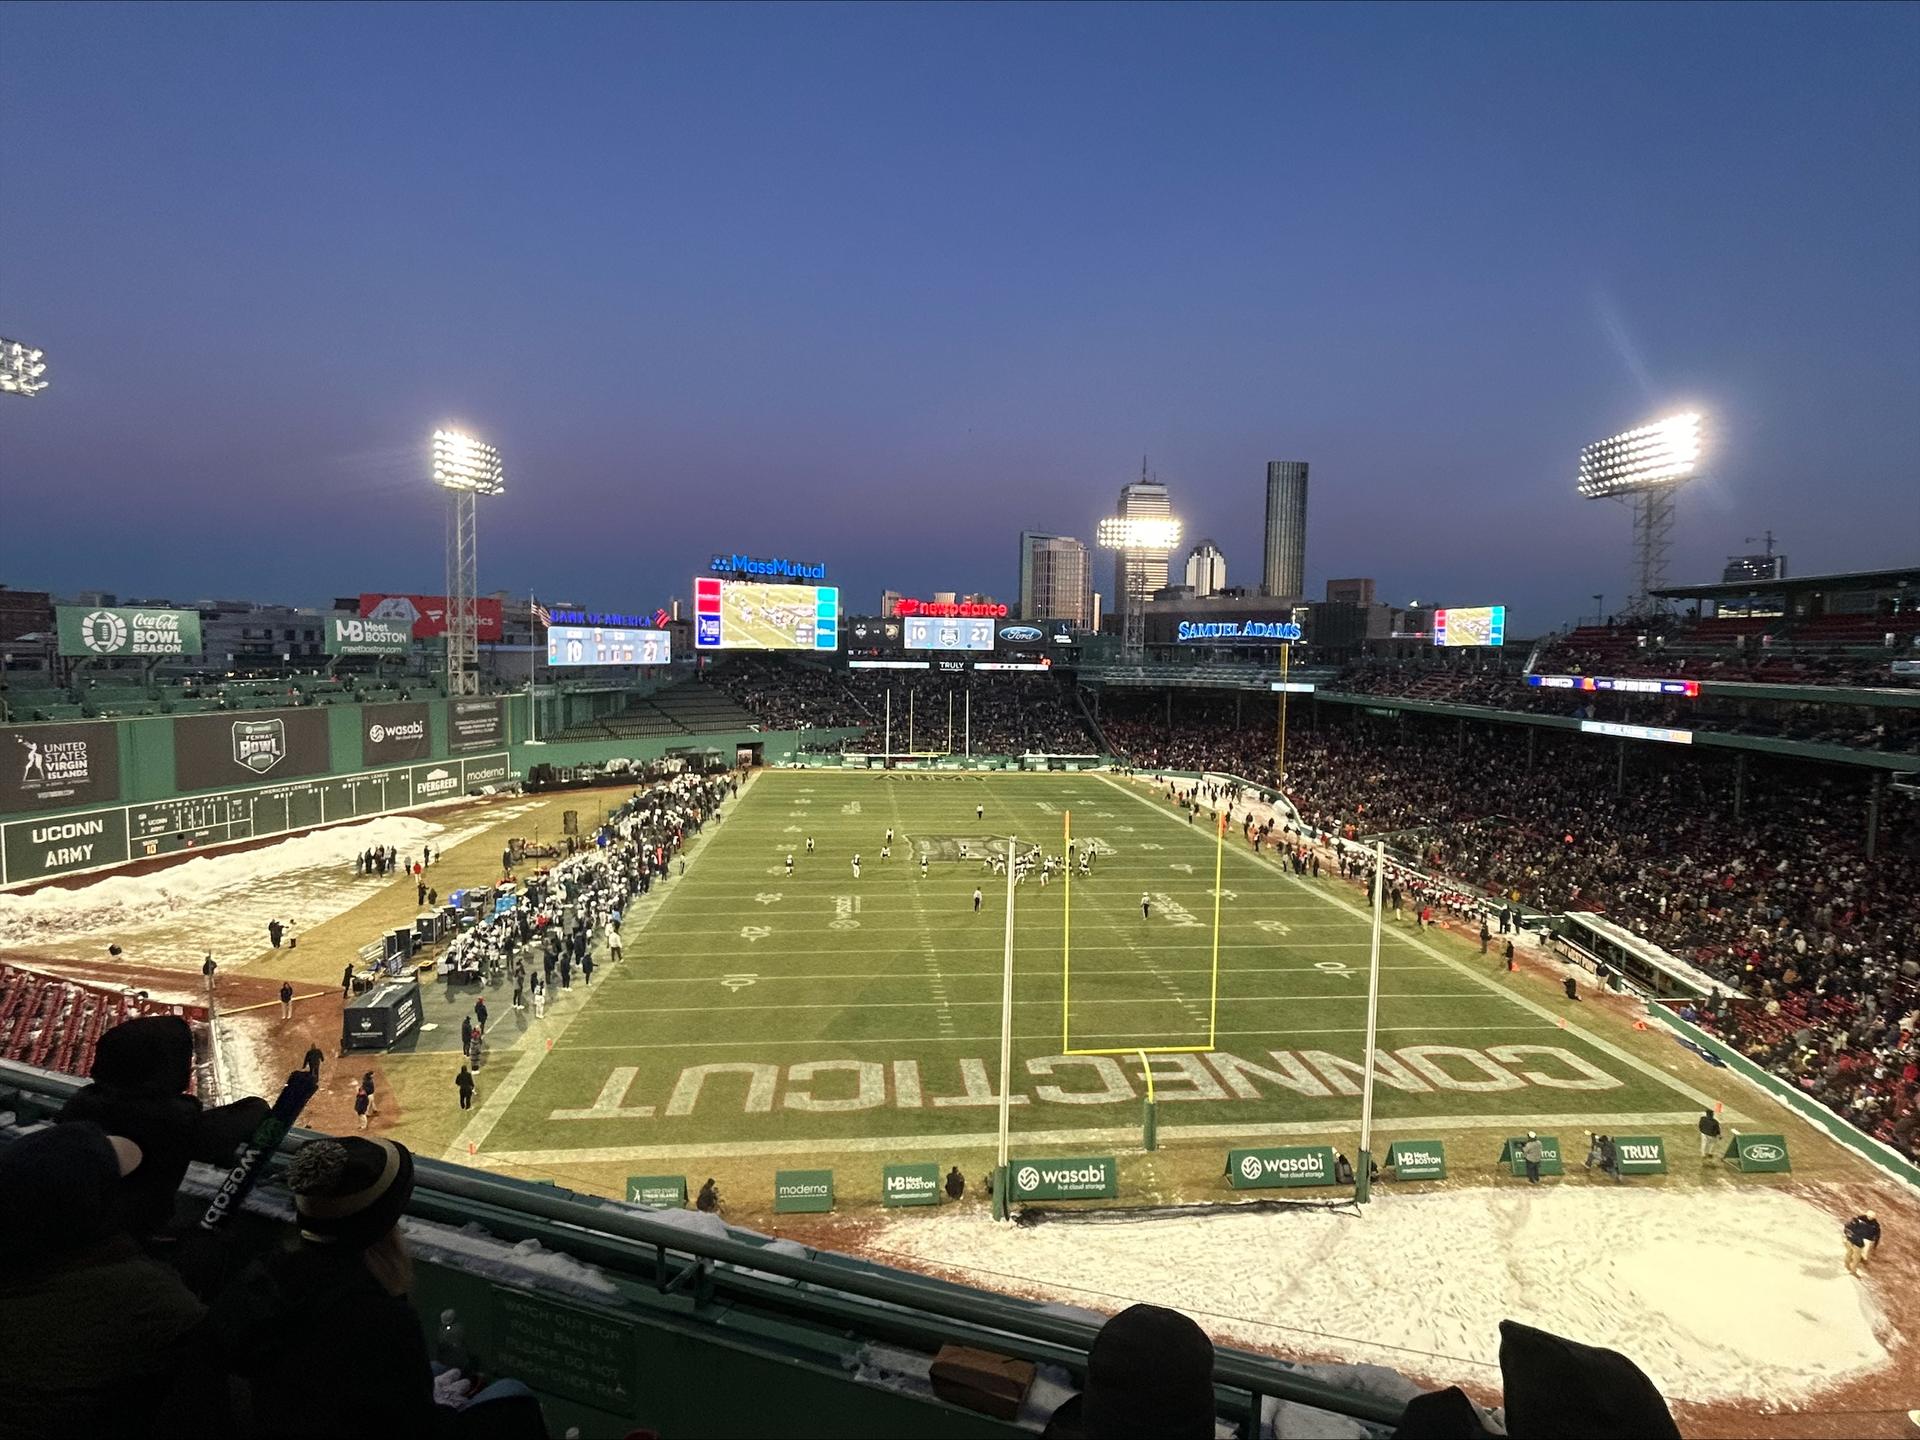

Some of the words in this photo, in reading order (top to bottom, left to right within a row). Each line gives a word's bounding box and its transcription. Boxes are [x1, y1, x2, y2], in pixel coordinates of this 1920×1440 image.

[732, 554, 825, 579] MassMutual
[550, 608, 585, 624] BANK
[604, 613, 651, 627] AMERICA
[364, 621, 389, 632] Meet
[1007, 625, 1034, 640] Ford
[1178, 620, 1241, 640] SAMUEL
[1242, 620, 1301, 640] ADAMS
[133, 630, 182, 643] BOWL
[365, 632, 407, 643] BOSTON
[912, 627, 927, 640] 10
[971, 628, 988, 640] 27
[132, 644, 182, 653] SEASON
[341, 645, 402, 654] meetboston.com
[940, 661, 964, 669] TRULY
[385, 720, 423, 736] wasabi
[44, 741, 87, 752] UNITED
[240, 738, 281, 759] BOWL
[45, 751, 87, 763] STATES
[45, 760, 88, 771] VIRGIN
[47, 769, 89, 780] ISLANDS
[466, 767, 505, 781] moderna
[260, 786, 290, 795] AMERICAN
[291, 783, 312, 791] LEAGUE
[417, 778, 458, 794] EVERGREEN
[154, 800, 197, 811] FENWAY
[32, 820, 104, 844] UCONN
[45, 844, 94, 868] ARMY
[548, 1044, 1625, 1120] CONNECTICUT
[1515, 1150, 1557, 1160] mrna
[1620, 1144, 1660, 1160] TRULY
[1751, 1146, 1777, 1159] Ford
[1263, 1153, 1323, 1172] wasabi
[1414, 1157, 1441, 1165] BOSTON
[1042, 1164, 1105, 1184] wasabi
[200, 1147, 261, 1230] wasabi
[779, 1184, 828, 1195] moderna
[906, 1181, 936, 1190] BOSTON
